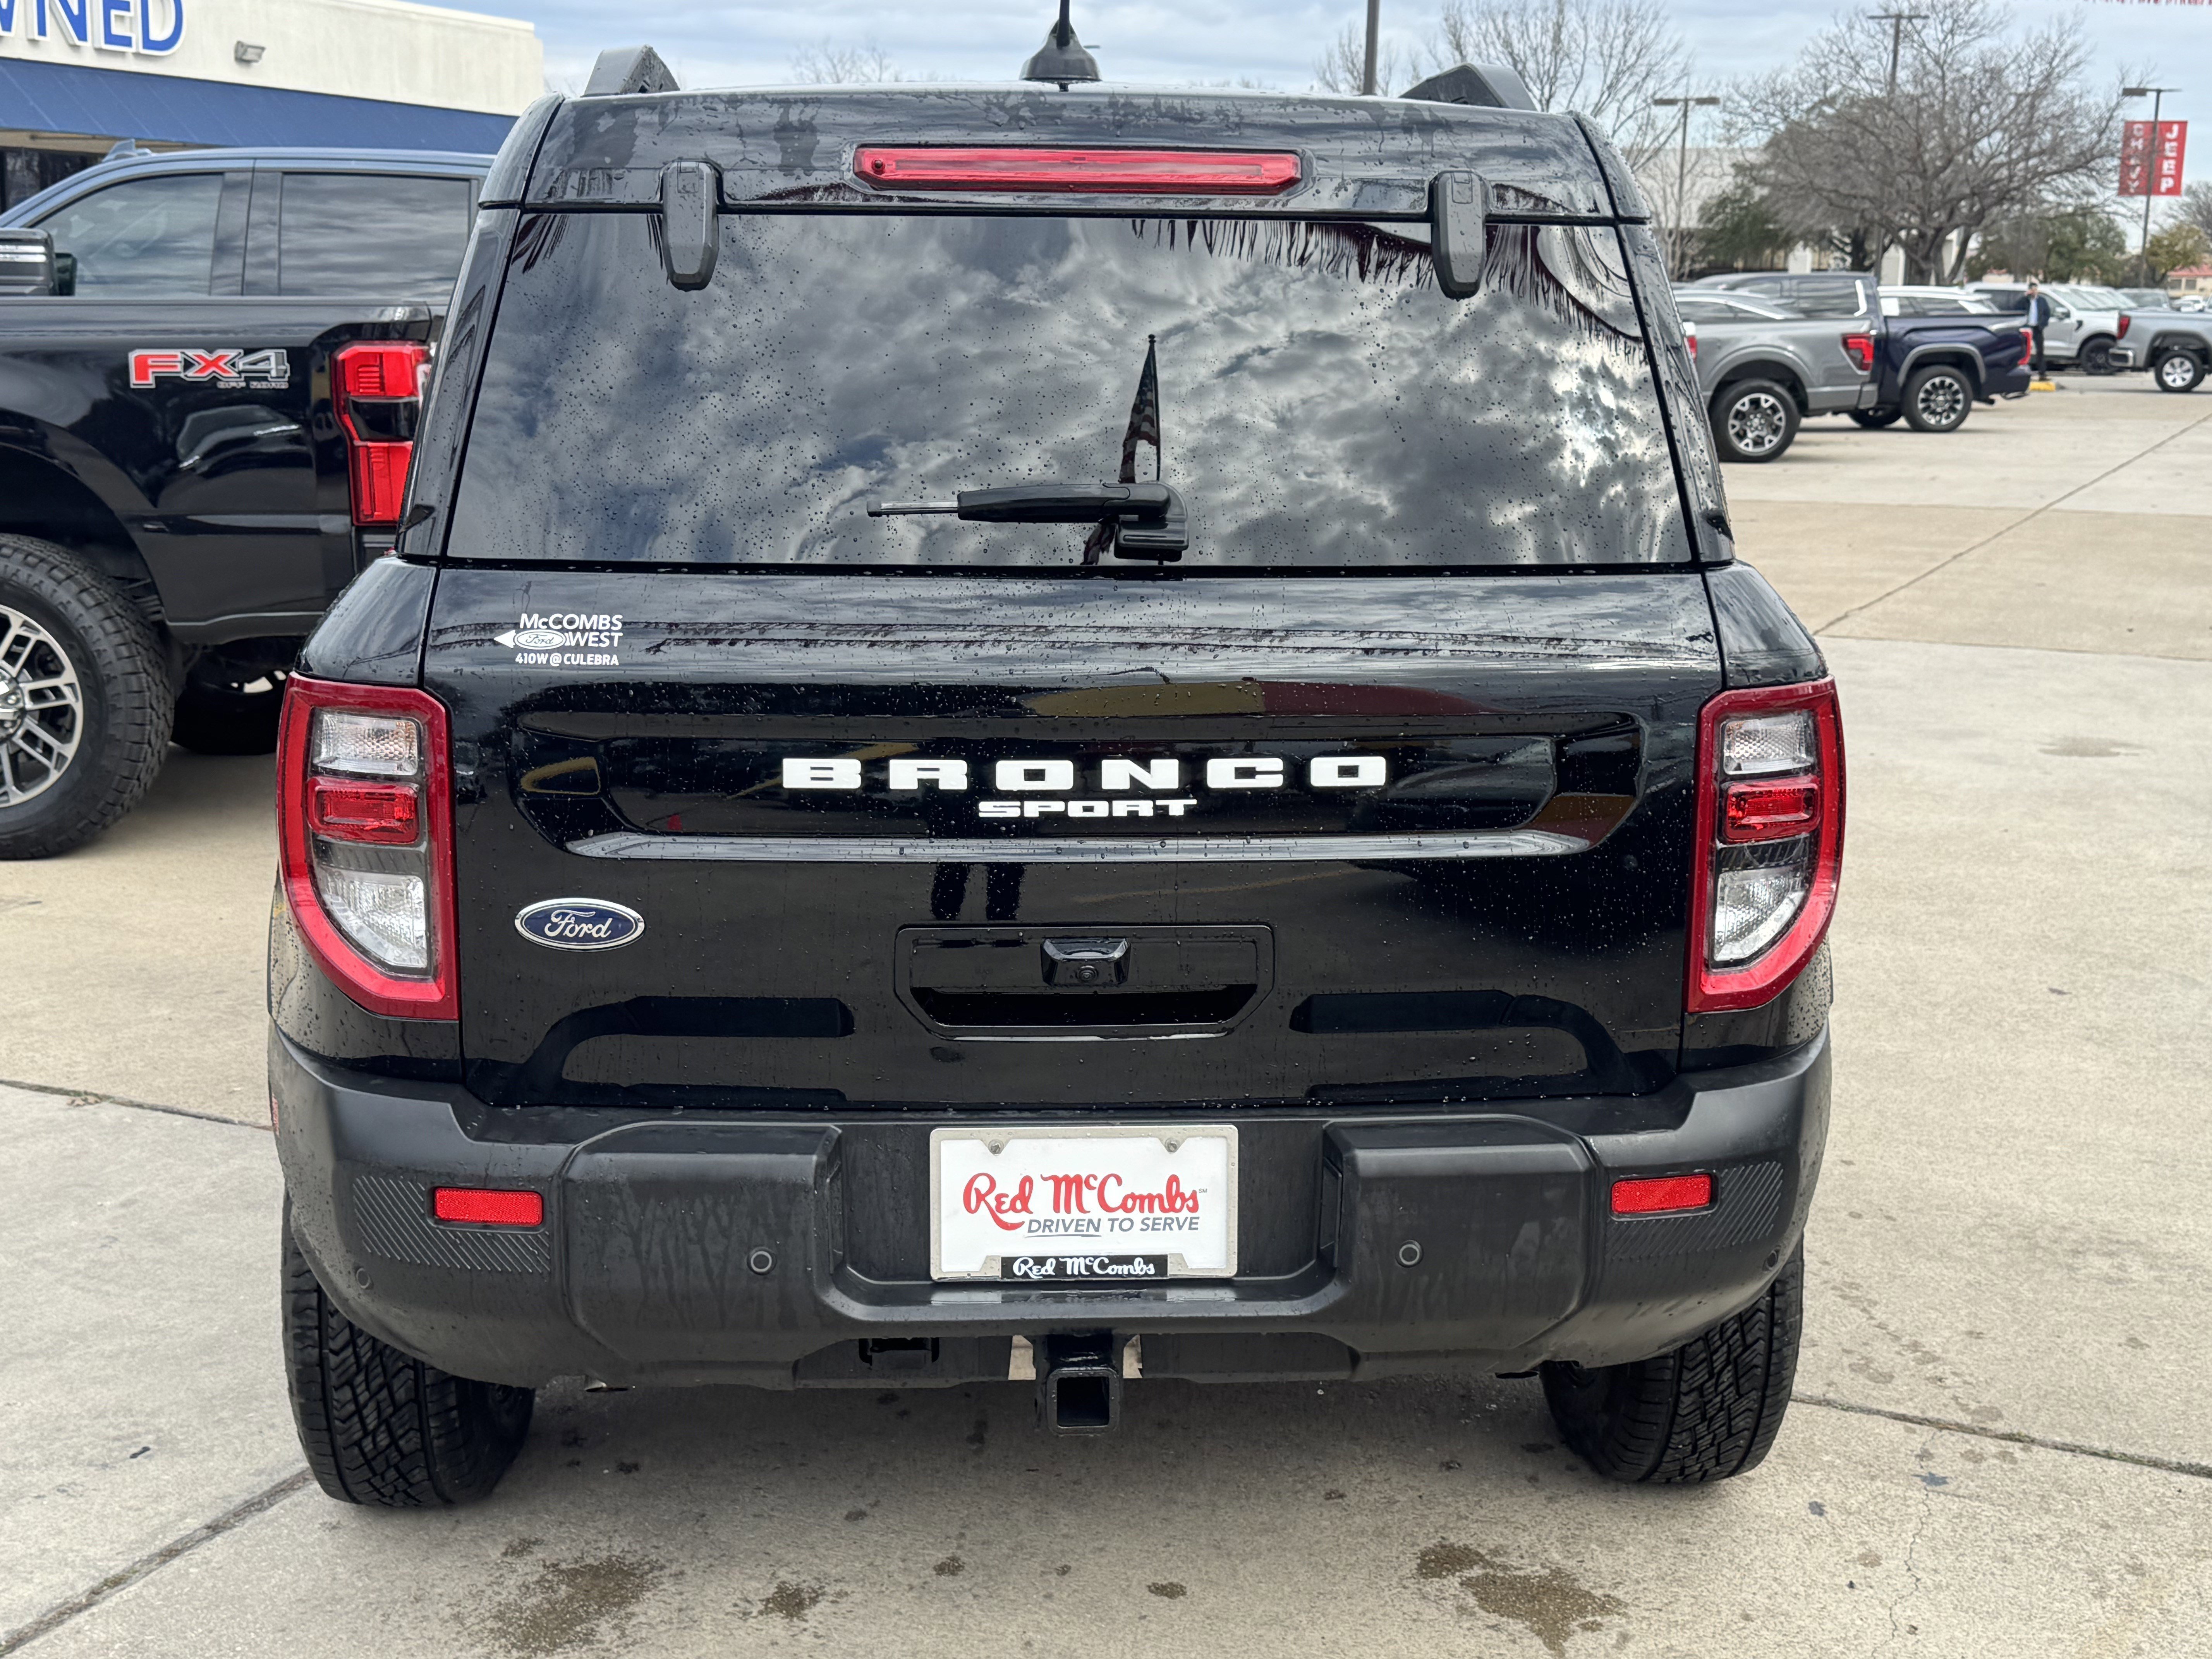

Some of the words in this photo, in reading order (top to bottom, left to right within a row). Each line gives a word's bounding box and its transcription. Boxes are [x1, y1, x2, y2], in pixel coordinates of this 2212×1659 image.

[2160, 123, 2179, 193] JEEP
[129, 349, 290, 388] FX4
[520, 613, 623, 630] McCOMBS
[526, 634, 554, 644] Ford
[568, 632, 623, 647] WEST
[782, 756, 1387, 790] BRONCO
[978, 799, 1197, 818] SPORT
[544, 909, 613, 938] Ford
[963, 1173, 1034, 1231] Red
[1040, 1173, 1199, 1214] McCombs
[1027, 1218, 1101, 1233] DRIVEN
[1108, 1218, 1134, 1232] TO
[1140, 1216, 1200, 1231] SERVE
[1013, 1256, 1055, 1279] Red
[1059, 1257, 1155, 1276] McCombs
